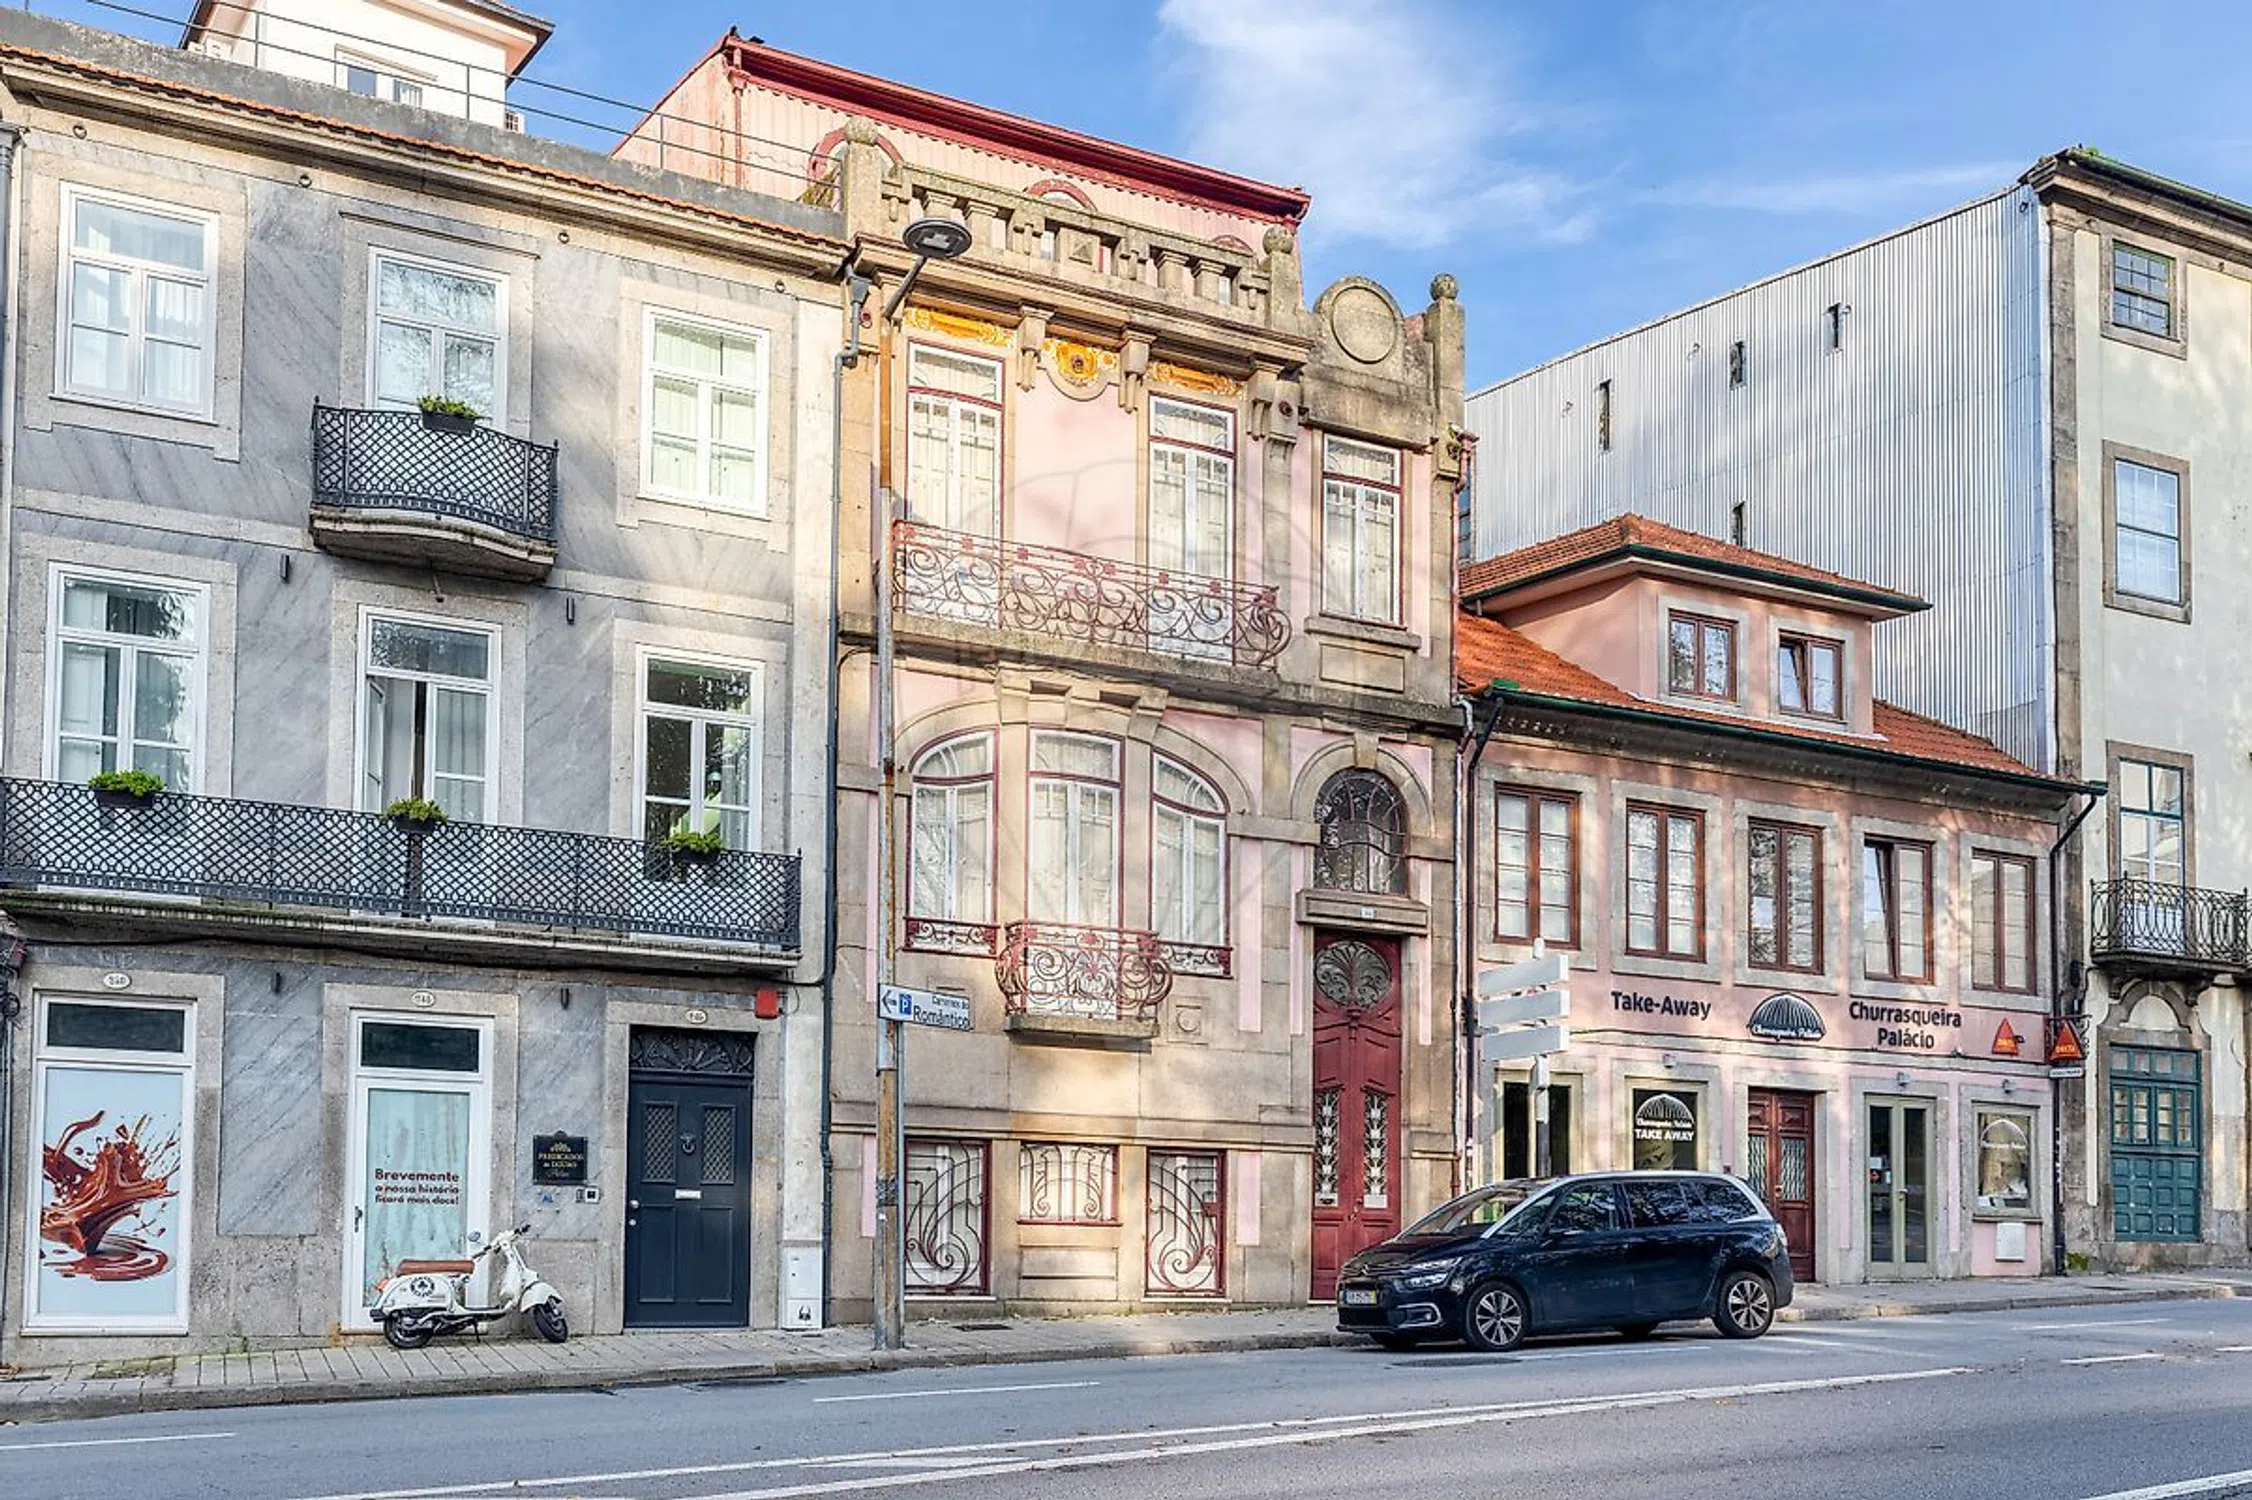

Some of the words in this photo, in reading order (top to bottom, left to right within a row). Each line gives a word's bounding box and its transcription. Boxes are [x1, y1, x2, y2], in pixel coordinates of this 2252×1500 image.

[1611, 991, 1711, 1021] Take-Away
[1849, 1001, 1962, 1028] Churrasqueira
[913, 1005, 970, 1028] Romântico
[1878, 1027, 1935, 1049] Palácio
[1634, 1128, 1662, 1139] TAKE
[1664, 1131, 1695, 1142] AWAY
[375, 1168, 460, 1182] Brevemente
[384, 1185, 416, 1194] nossa
[418, 1184, 459, 1194] história
[375, 1193, 404, 1204] ficará
[407, 1196, 430, 1205] mais
[432, 1196, 459, 1206] doce!
